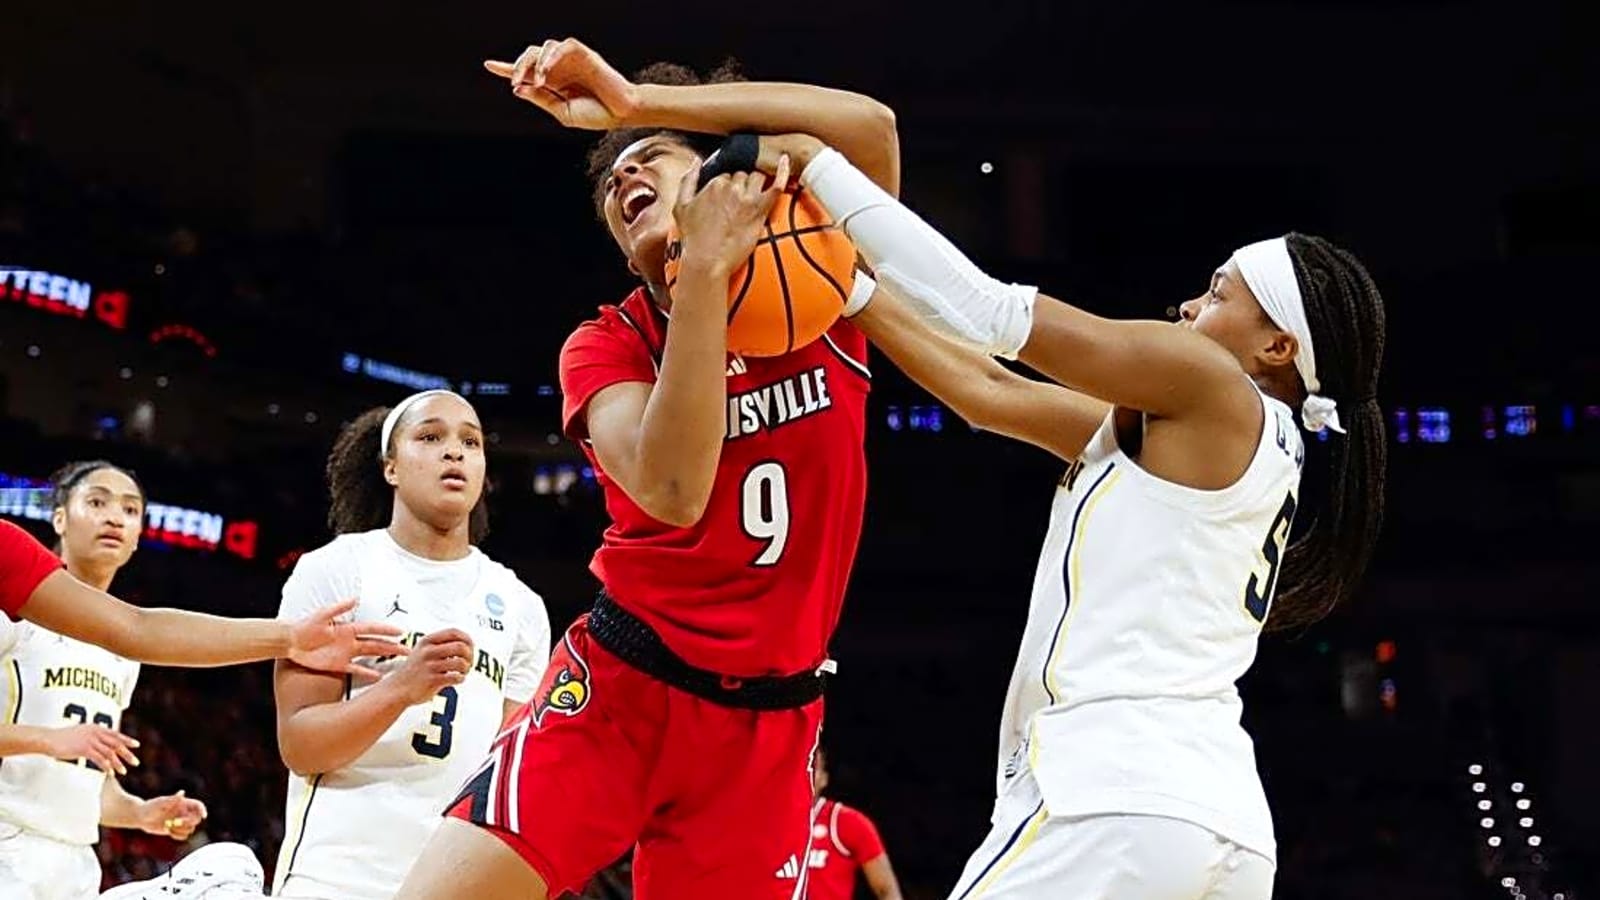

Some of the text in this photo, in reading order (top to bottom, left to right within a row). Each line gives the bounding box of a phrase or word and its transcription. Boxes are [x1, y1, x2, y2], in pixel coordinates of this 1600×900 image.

[728, 368, 831, 439] ISVILLE
[146, 504, 223, 544] TEEN
[743, 462, 789, 565] 9
[411, 686, 458, 759] 3
